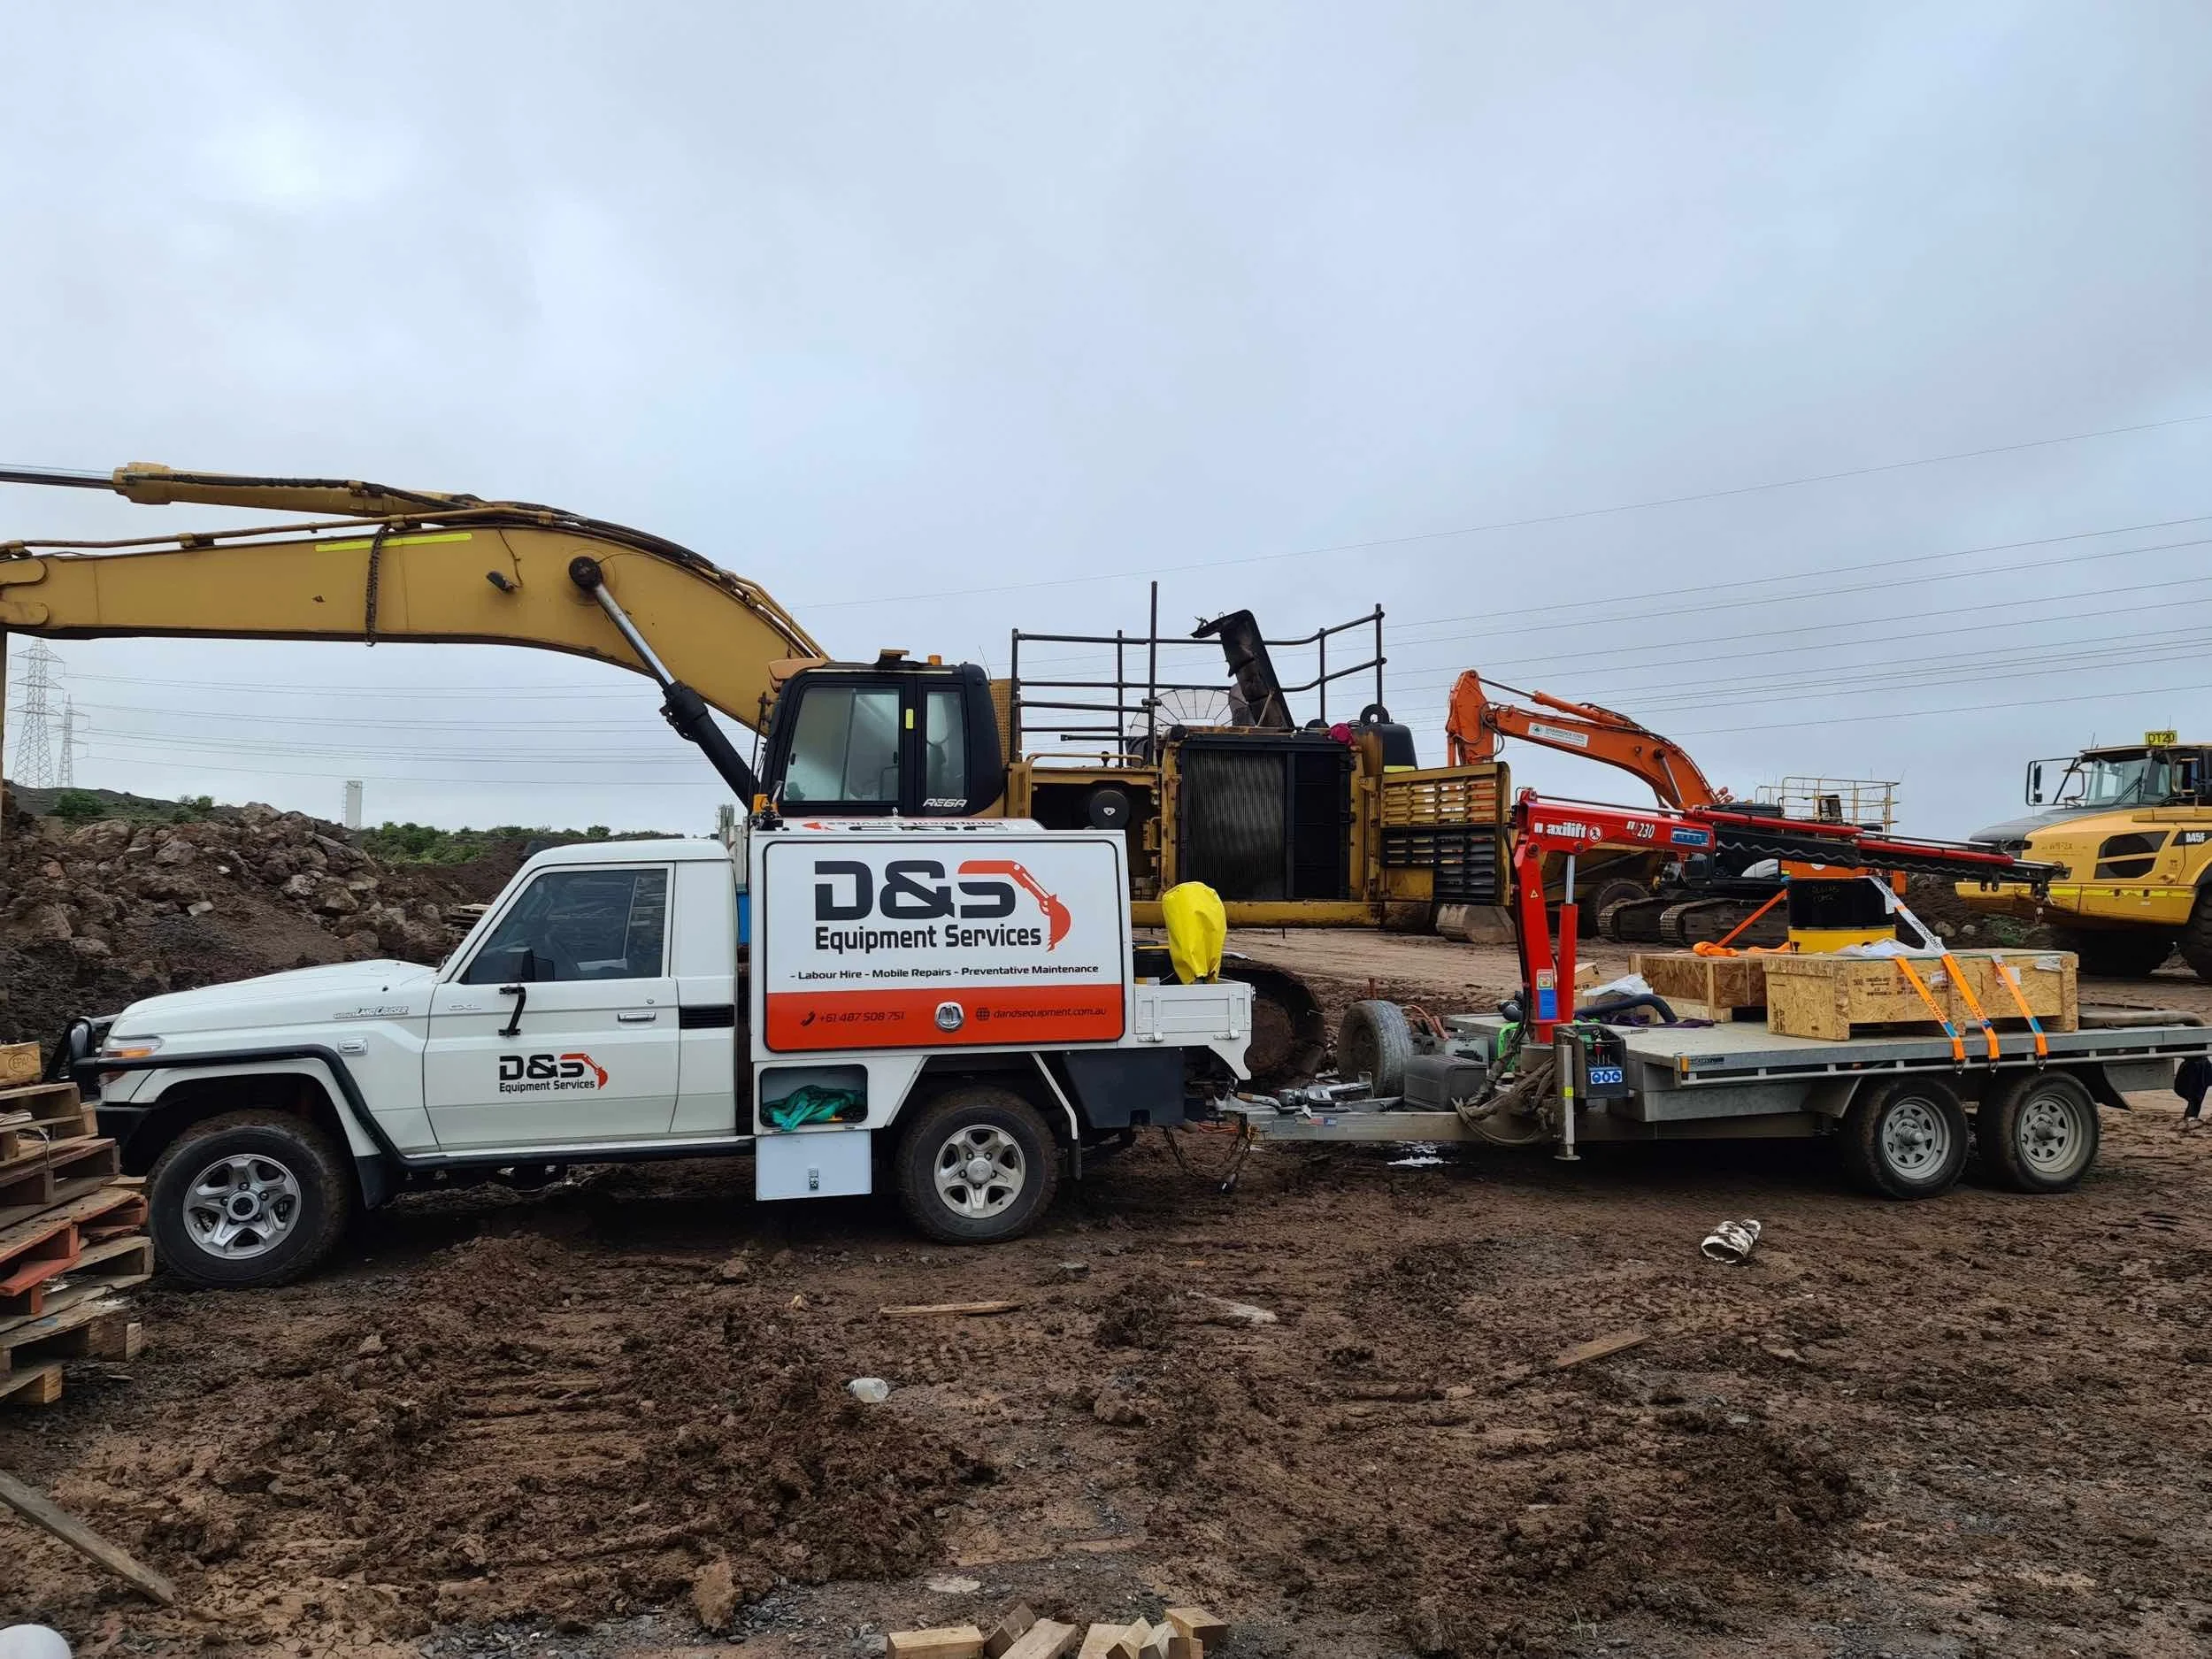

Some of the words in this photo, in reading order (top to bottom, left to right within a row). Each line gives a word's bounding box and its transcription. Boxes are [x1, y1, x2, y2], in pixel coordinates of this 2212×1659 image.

[815, 860, 1019, 921] D&S
[815, 925, 938, 955] Equipment
[944, 924, 1042, 949] Services
[798, 971, 837, 979] Labour
[840, 970, 863, 979] Hire
[872, 968, 910, 978] Mobile
[911, 968, 952, 979] Repairs
[961, 965, 1029, 976] Preventative
[1032, 964, 1099, 974] Maintenance
[819, 1012, 837, 1024] +61
[840, 1012, 860, 1023] 487
[888, 1010, 906, 1021] 751
[993, 1007, 1107, 1019] dandsequipment.com.au
[499, 1054, 585, 1080] D&S
[499, 1081, 551, 1094] Equipment
[554, 1079, 596, 1090] Services
